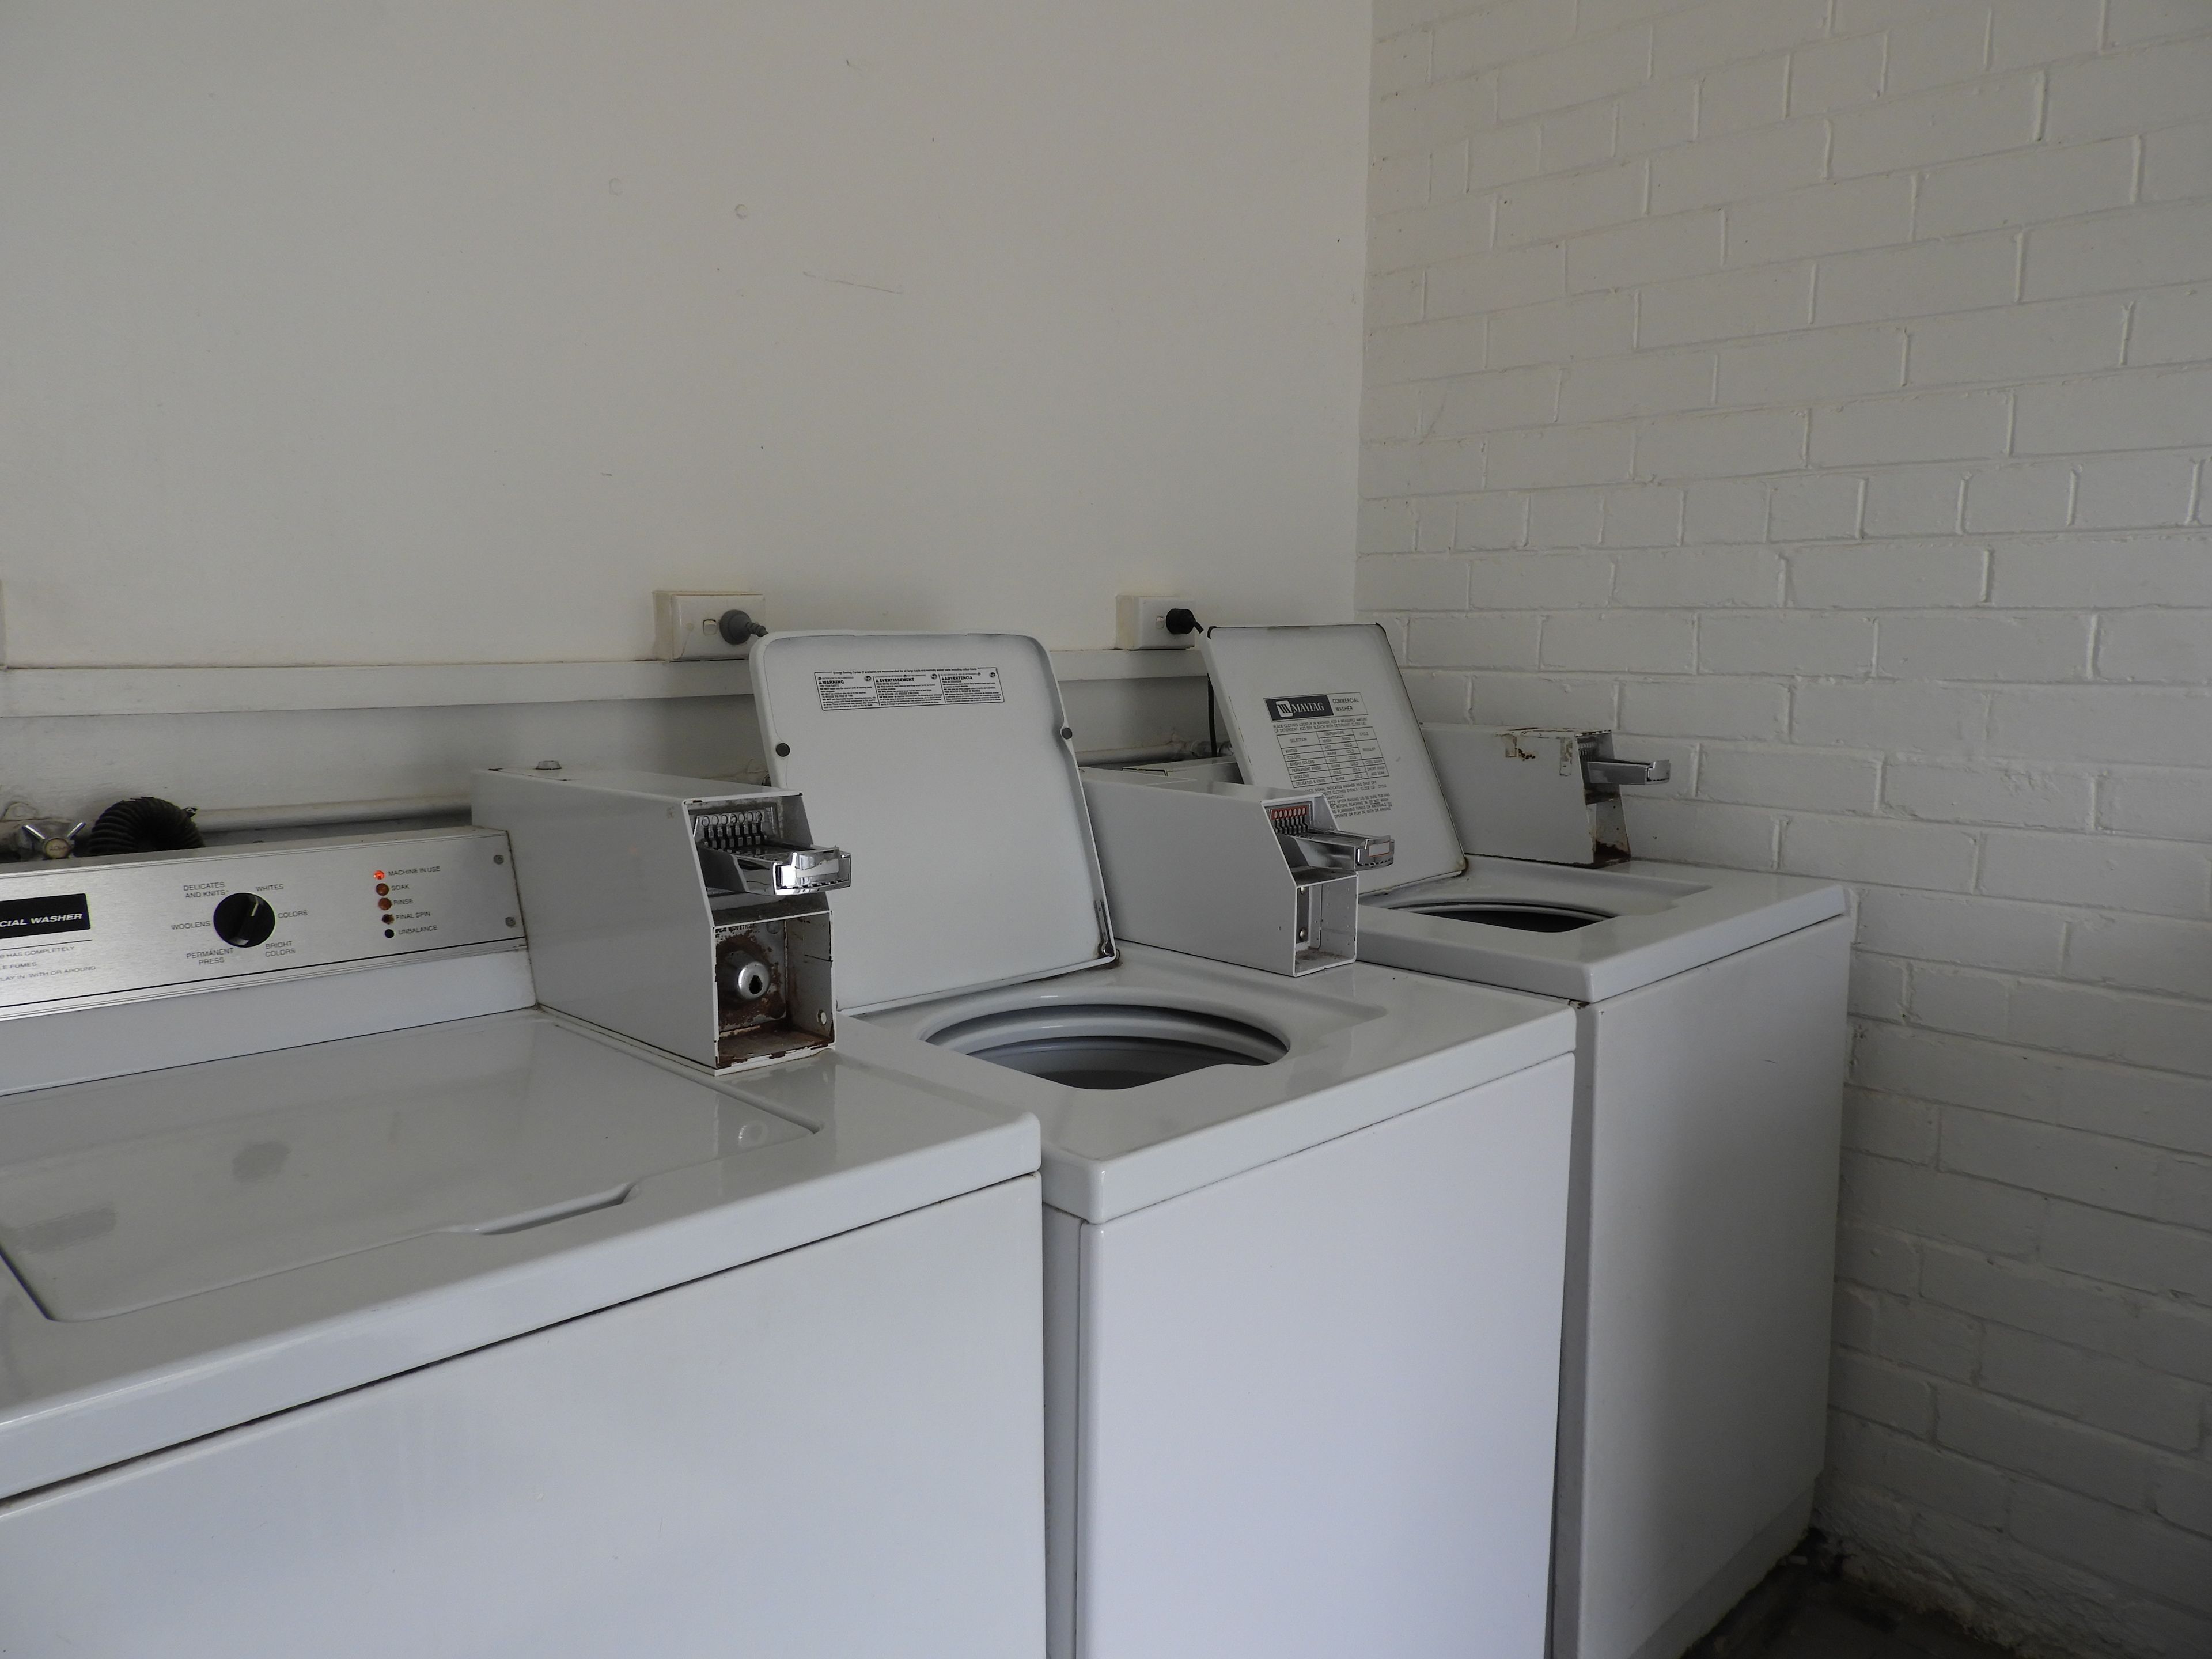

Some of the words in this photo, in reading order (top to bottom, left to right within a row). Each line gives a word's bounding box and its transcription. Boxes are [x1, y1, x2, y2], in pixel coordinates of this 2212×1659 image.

[1291, 702, 1324, 713] MAYTAG
[183, 882, 225, 891] DELICATES
[30, 913, 83, 924] WASHER
[278, 910, 308, 919] COLORS
[171, 921, 211, 930] WOOLENS
[398, 925, 437, 935] UNBALANCE
[266, 941, 293, 949] BRIGHT
[25, 946, 74, 956] COMPLETELY
[186, 948, 233, 959] PERMANENT
[265, 948, 296, 957] COLORS
[199, 957, 225, 965] PRESS
